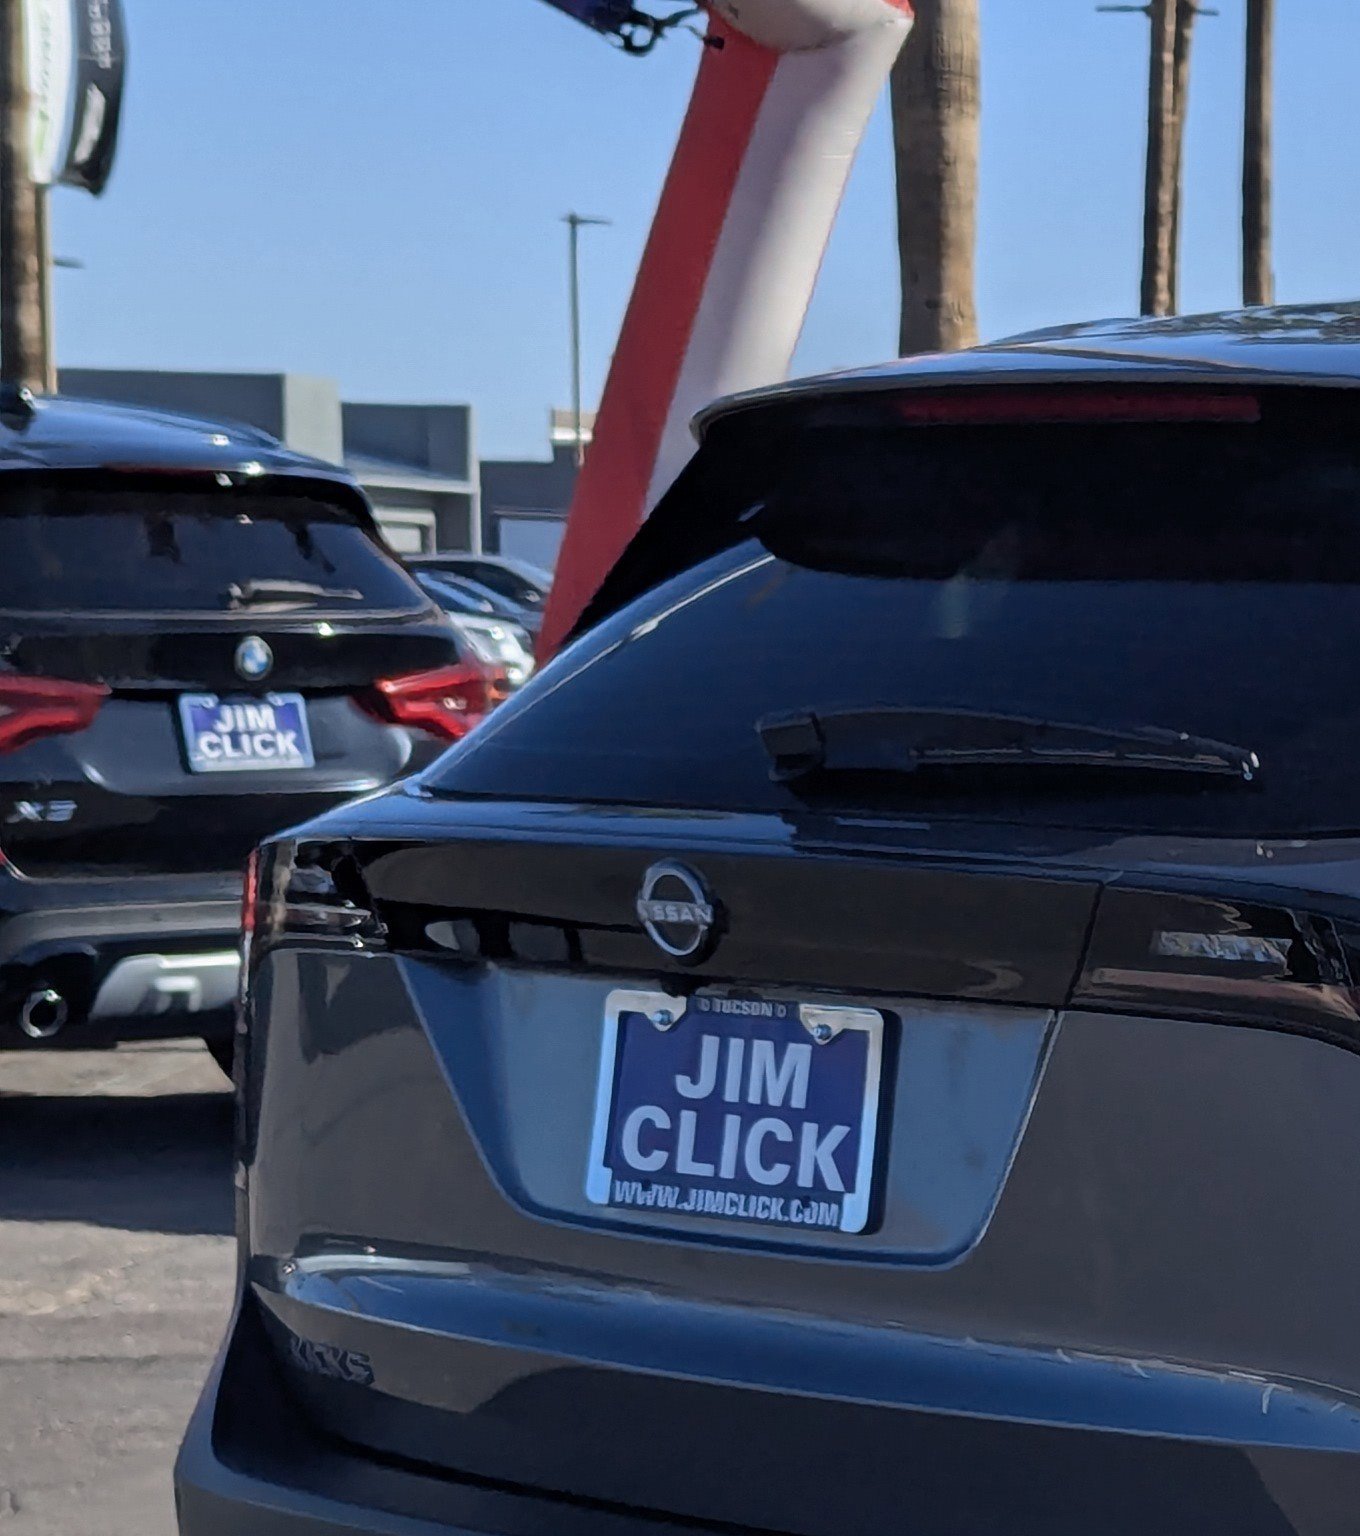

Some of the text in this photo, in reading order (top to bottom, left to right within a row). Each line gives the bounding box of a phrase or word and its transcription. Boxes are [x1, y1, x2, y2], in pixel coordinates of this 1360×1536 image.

[213, 704, 277, 732] JIM
[199, 731, 302, 759] CLICK
[712, 998, 773, 1018] TUCSON
[675, 1034, 813, 1110] JIM
[621, 1104, 851, 1192] CLICK
[613, 1179, 840, 1227] WWW.JIMCLICK.COM
